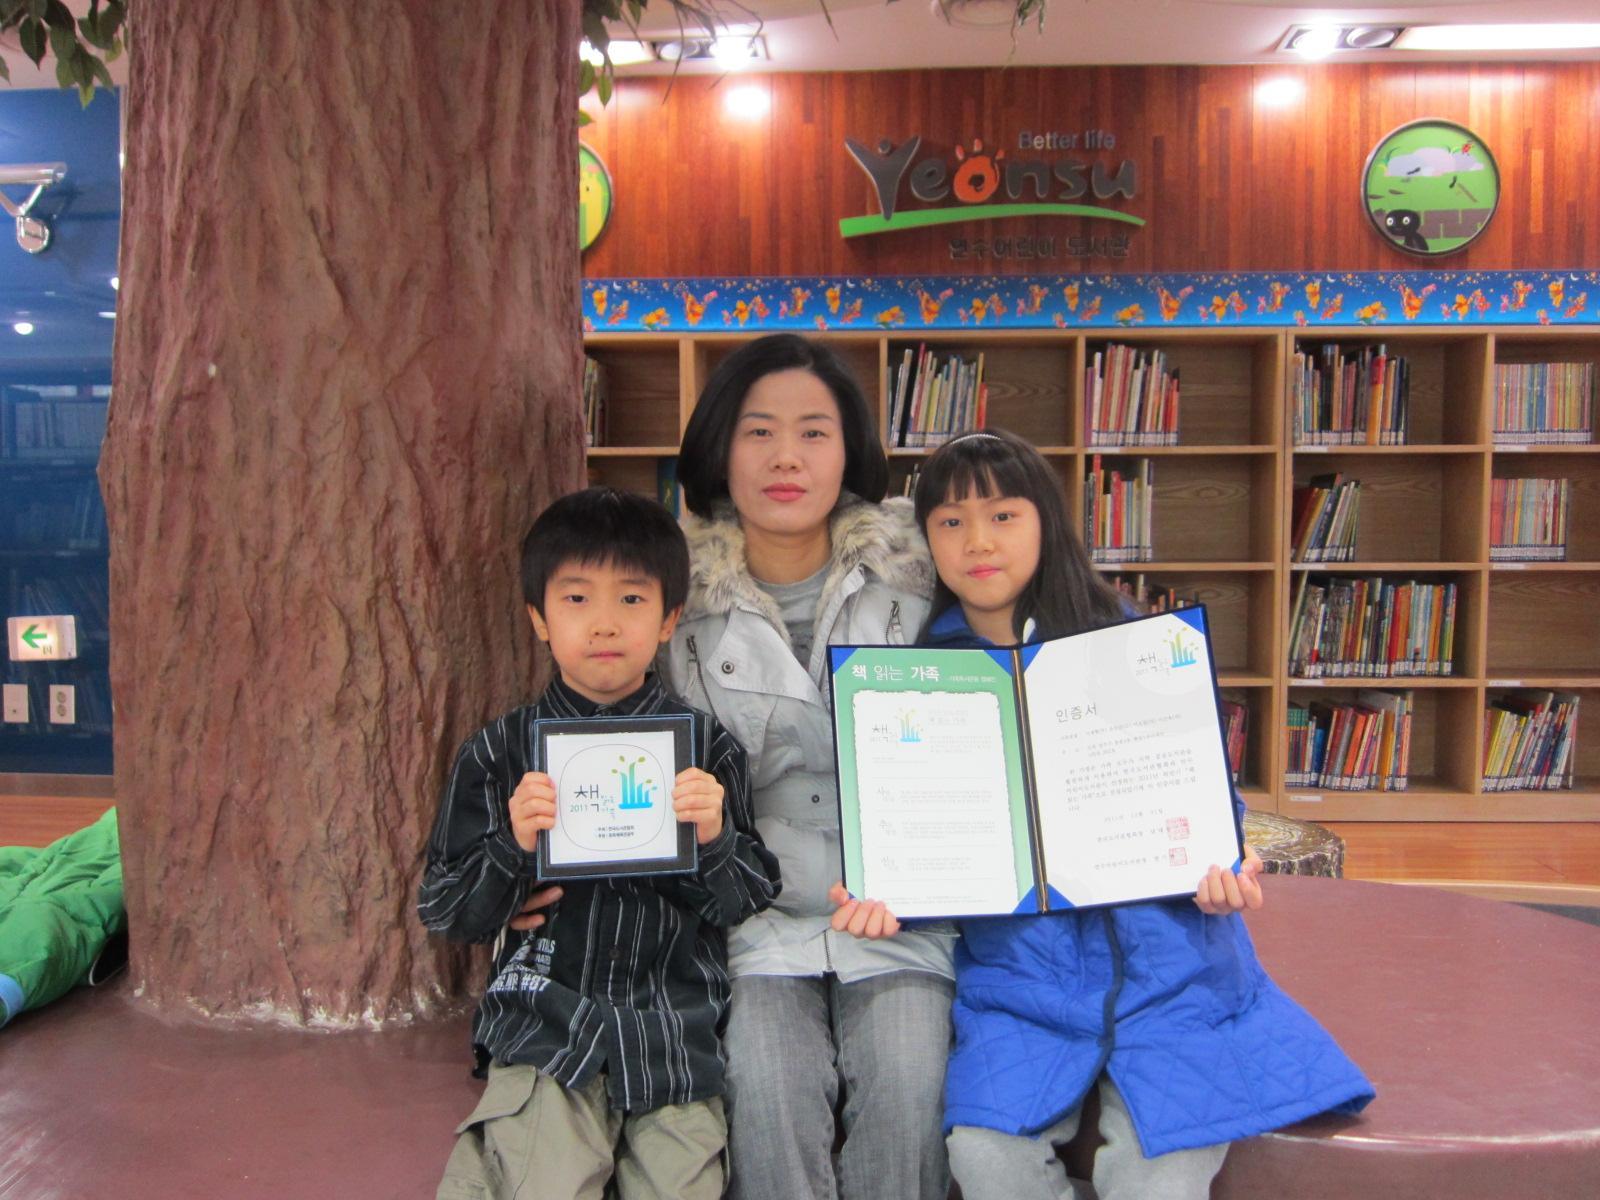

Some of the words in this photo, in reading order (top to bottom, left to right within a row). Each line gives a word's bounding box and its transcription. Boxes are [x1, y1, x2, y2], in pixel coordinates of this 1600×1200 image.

[1018, 131, 1077, 150] Better
[1084, 130, 1117, 149] life
[843, 135, 1138, 221] Yeonsu
[1065, 235, 1131, 259] 도서관
[851, 664, 867, 681] 책
[873, 665, 904, 682] 읽는
[910, 665, 941, 682] 가족
[1055, 703, 1098, 723] 인증서
[569, 803, 589, 813] 2011
